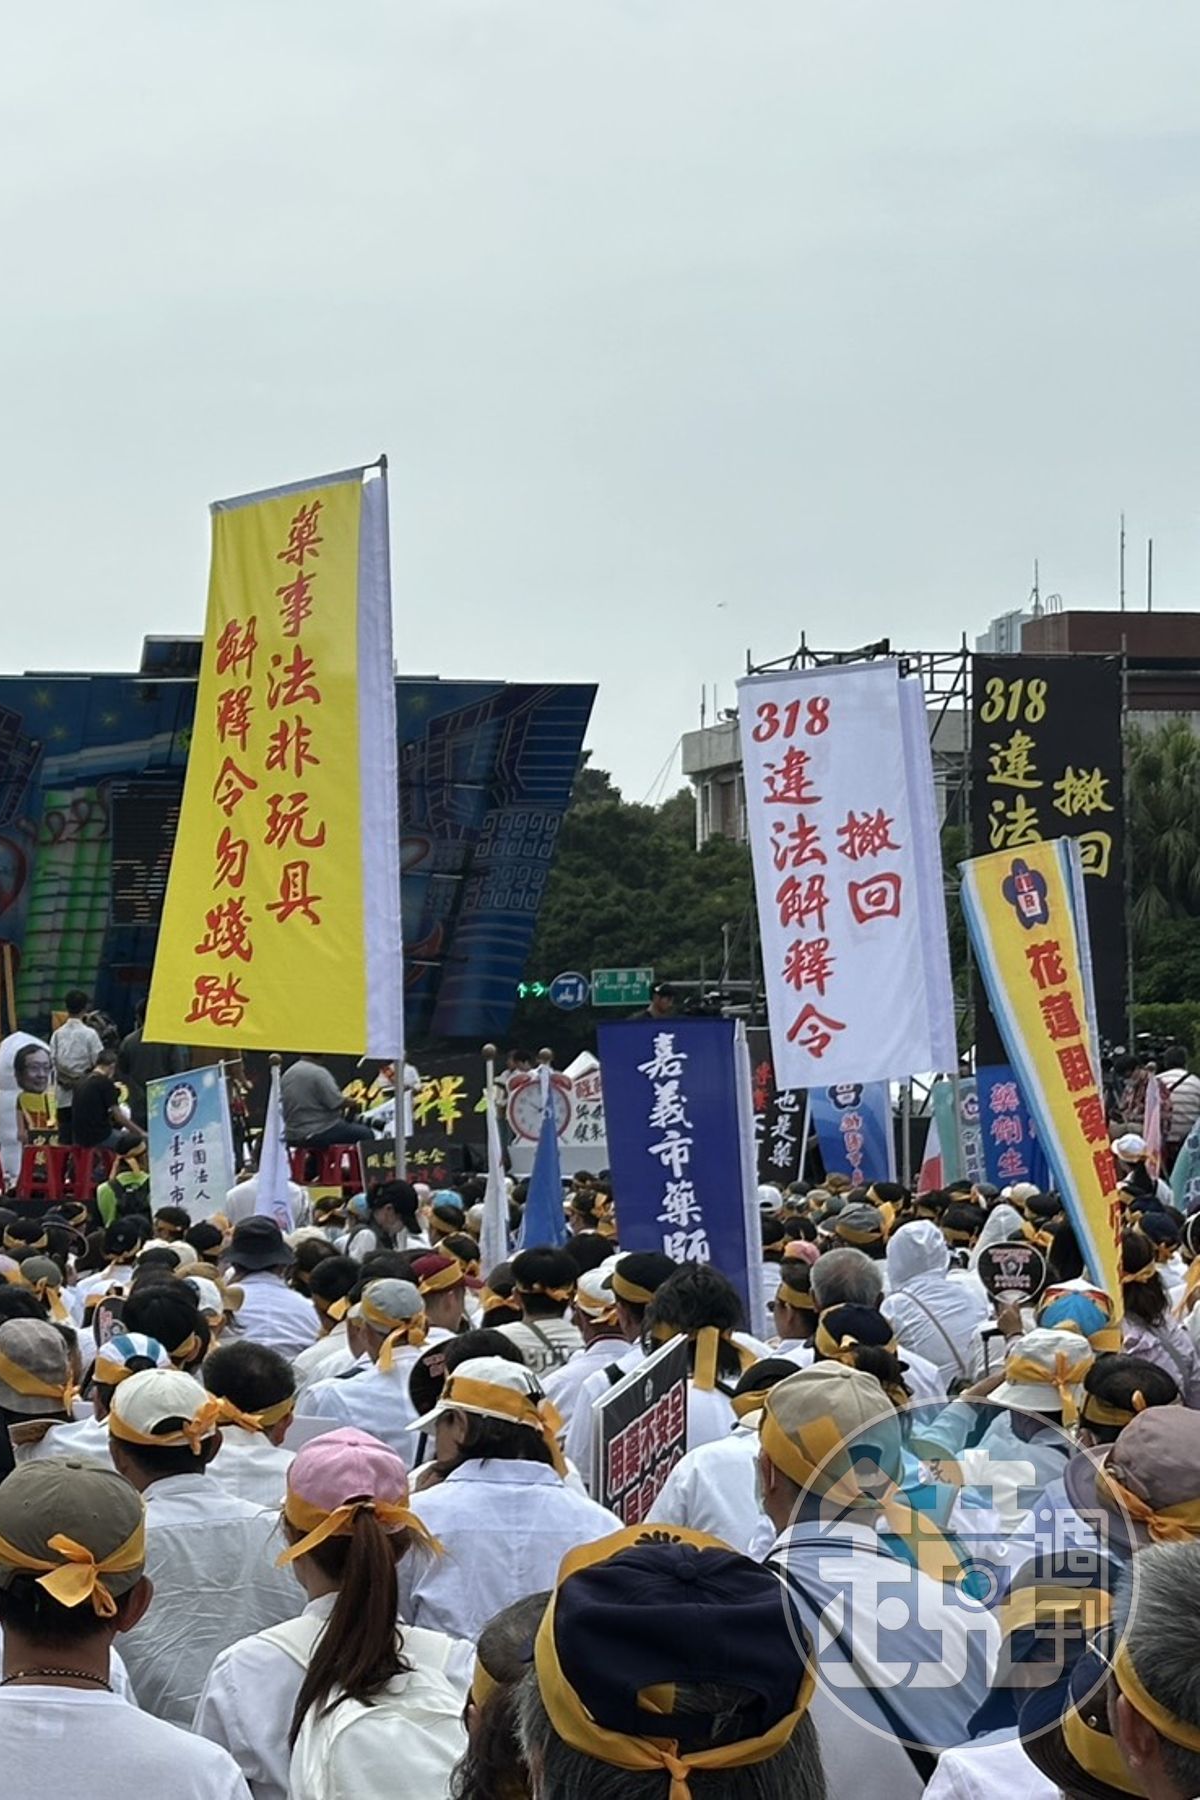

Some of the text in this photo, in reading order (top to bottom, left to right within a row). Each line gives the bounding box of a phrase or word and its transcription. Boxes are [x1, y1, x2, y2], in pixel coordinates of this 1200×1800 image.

[264, 500, 326, 925] 藥事法非玩具
[184, 615, 259, 1027] 解釋令勿踐踏
[836, 808, 902, 924] 撤回
[1053, 765, 1115, 878] 撤回
[169, 1135, 186, 1207] 臺中市
[192, 1131, 211, 1200] 社團法人
[636, 1032, 711, 1264] 嘉義市藥師
[768, 1090, 800, 1168] 也是藥
[607, 1378, 685, 1500] 用藥不安全
